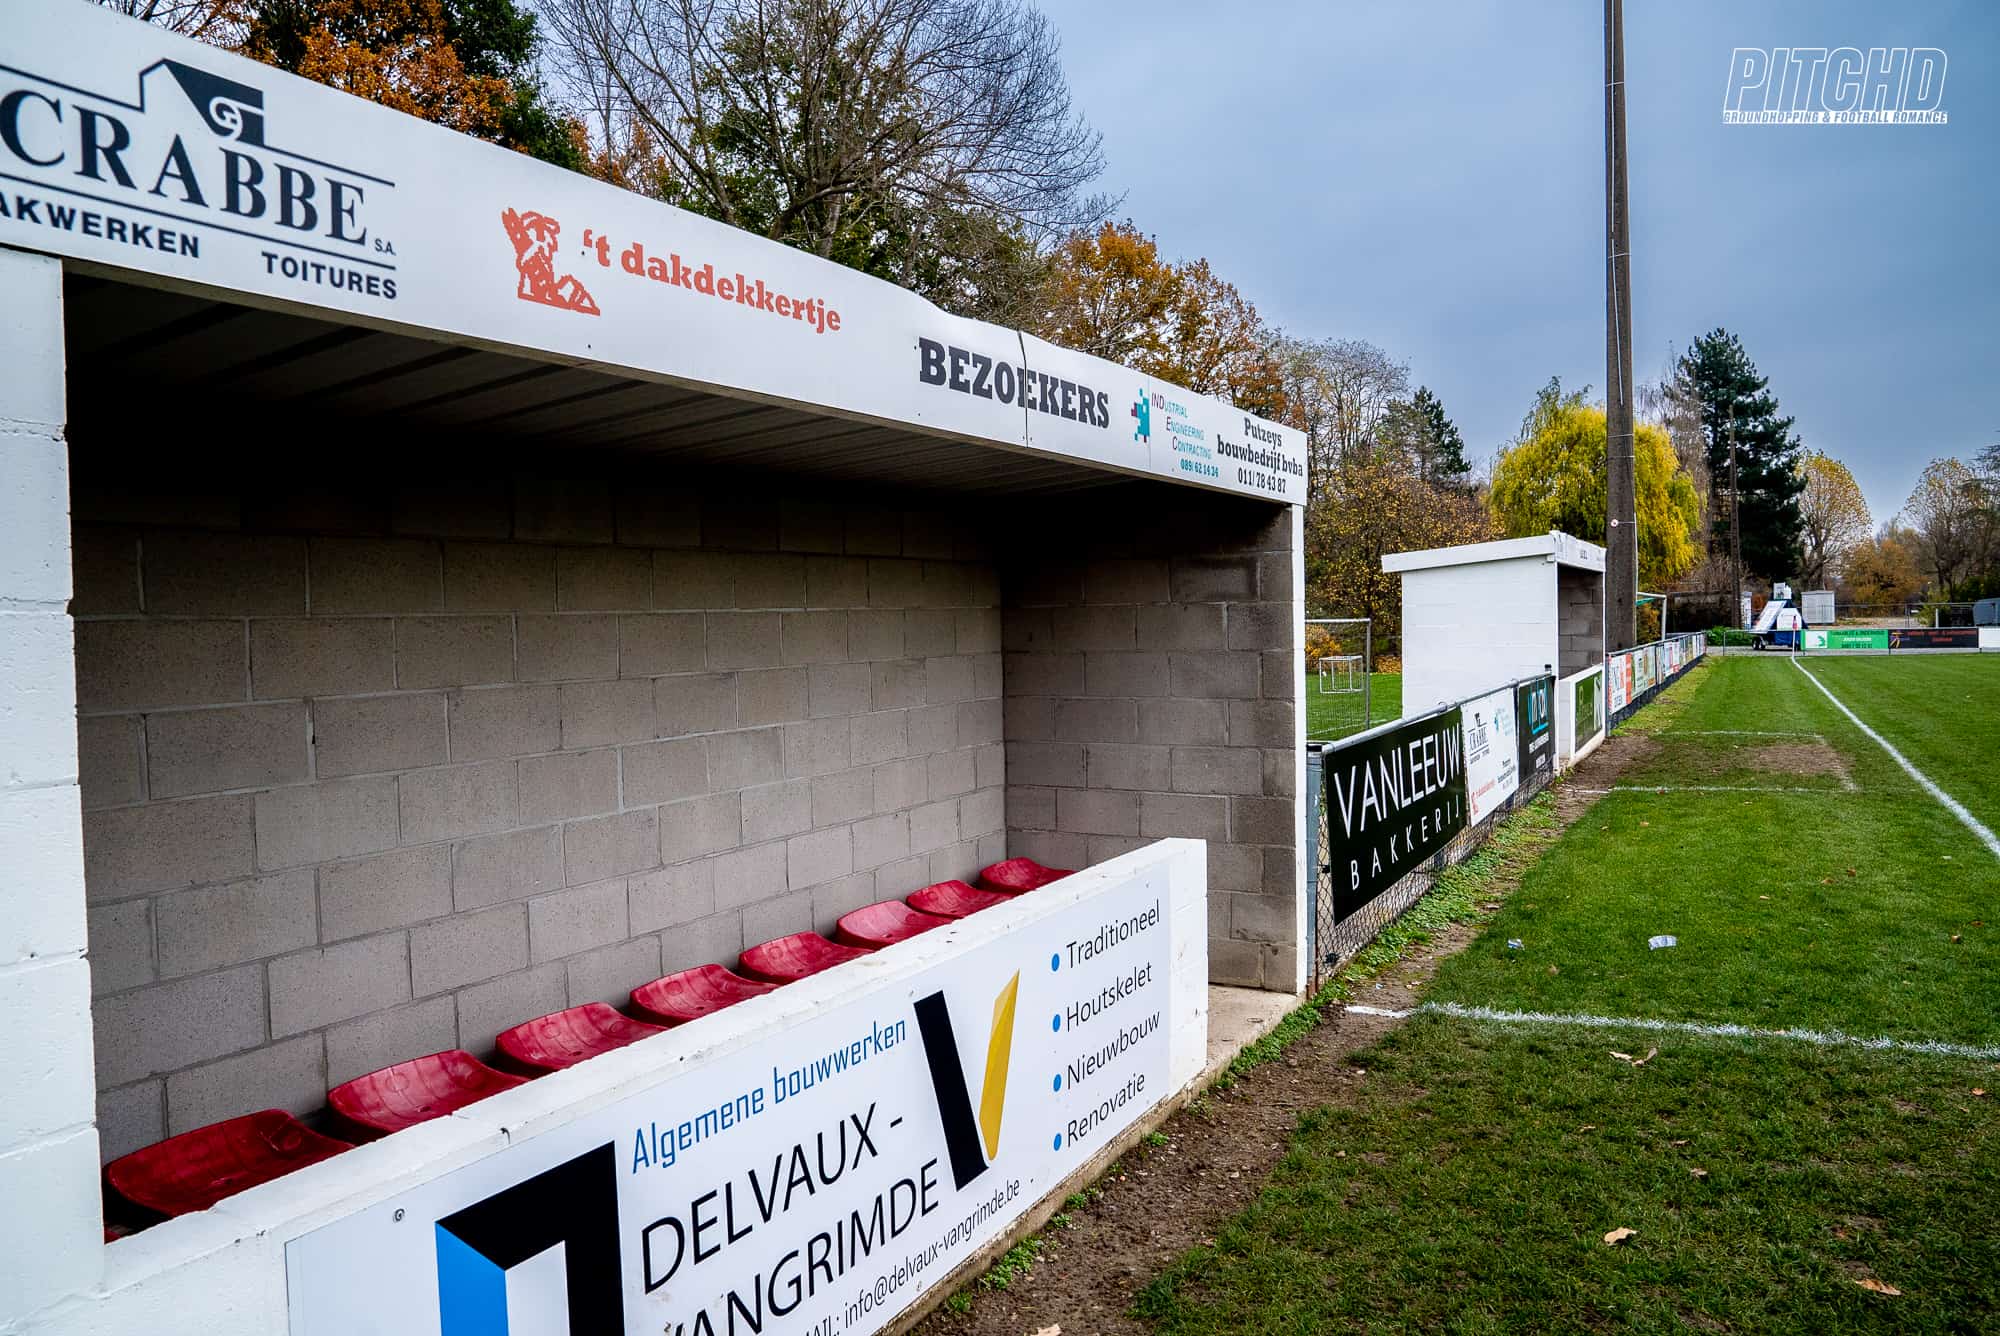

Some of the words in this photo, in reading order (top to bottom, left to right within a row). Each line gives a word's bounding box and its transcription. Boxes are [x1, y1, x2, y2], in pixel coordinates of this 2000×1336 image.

[0, 90, 367, 246] CRABBE
[262, 251, 397, 299] TOITURES
[620, 241, 841, 334] dakdekkertje
[919, 337, 1110, 429] BEZOEKERS
[1217, 434, 1281, 474] bouwbedrijf
[1282, 454, 1303, 477] bvba
[1244, 417, 1282, 450] Putzeys
[1256, 471, 1266, 489] 78
[1266, 474, 1276, 491] 43
[1277, 477, 1287, 494] 87
[1333, 722, 1461, 840] VANLEEUW
[1350, 794, 1460, 891] BAKKERIJ
[1066, 898, 1161, 969] Traditioneel
[1066, 961, 1153, 1033] Houtskelet
[1067, 1011, 1161, 1090] Nieuwbouw
[632, 1087, 765, 1175] Algemene
[772, 1019, 906, 1105] bouwwerken
[1067, 1072, 1146, 1149] Renovatie
[641, 1101, 878, 1295] DELVAUX
[844, 1178, 1021, 1330] info@delvaux-vangrimde.be
